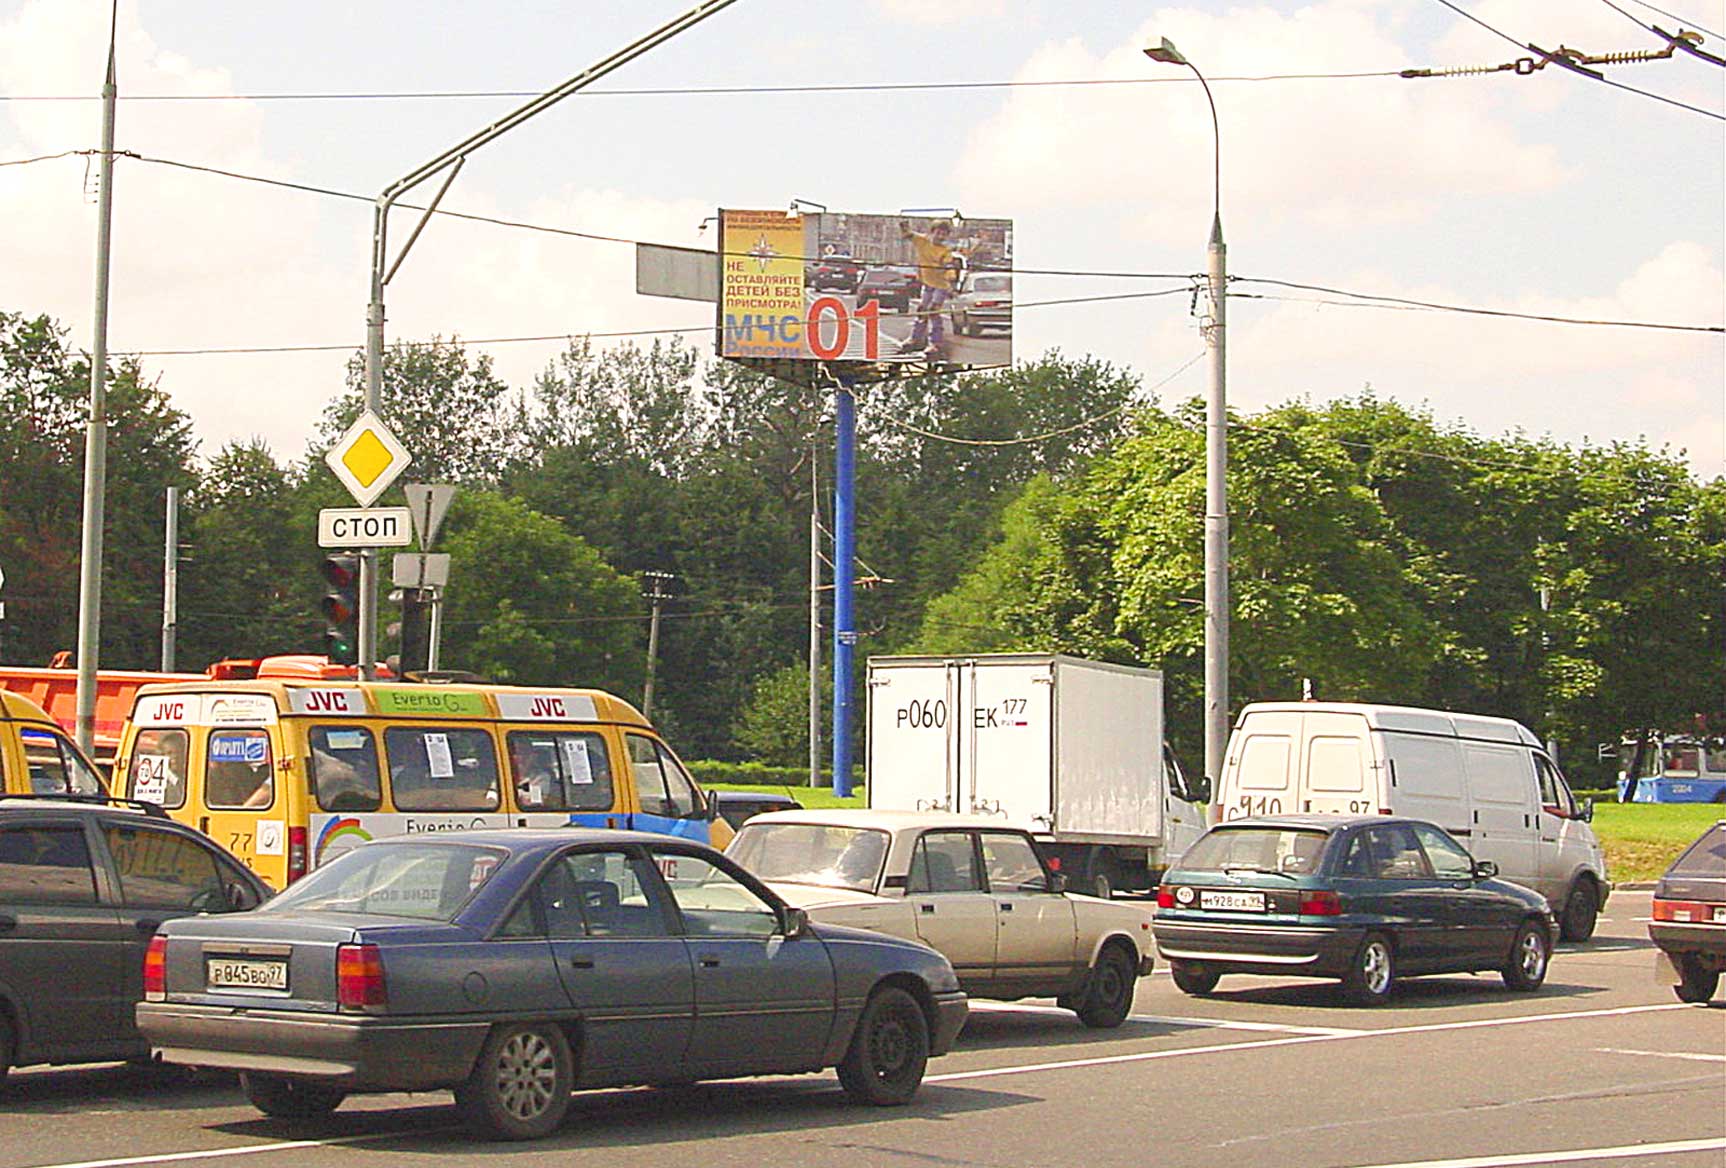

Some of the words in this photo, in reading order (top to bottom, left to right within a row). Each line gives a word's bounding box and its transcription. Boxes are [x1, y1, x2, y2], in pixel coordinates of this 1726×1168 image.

[726, 261, 745, 272] НЕ
[726, 274, 801, 285] ОСТАВЛЯЙТЕ
[726, 285, 769, 297] ДЕТЕЙ
[775, 286, 801, 297] БЕЗ
[726, 298, 802, 309] ПРИСМОТРА!
[726, 314, 800, 343] МЧС
[807, 297, 880, 360] 01
[333, 518, 396, 537] СТОП
[305, 691, 348, 711] JVC
[392, 692, 441, 706] Everio
[531, 698, 566, 717] JVC
[153, 703, 184, 720] JVC
[897, 699, 947, 728] Р060
[974, 707, 998, 728] ЕК
[1002, 699, 1027, 714] 177
[230, 832, 253, 852] 77
